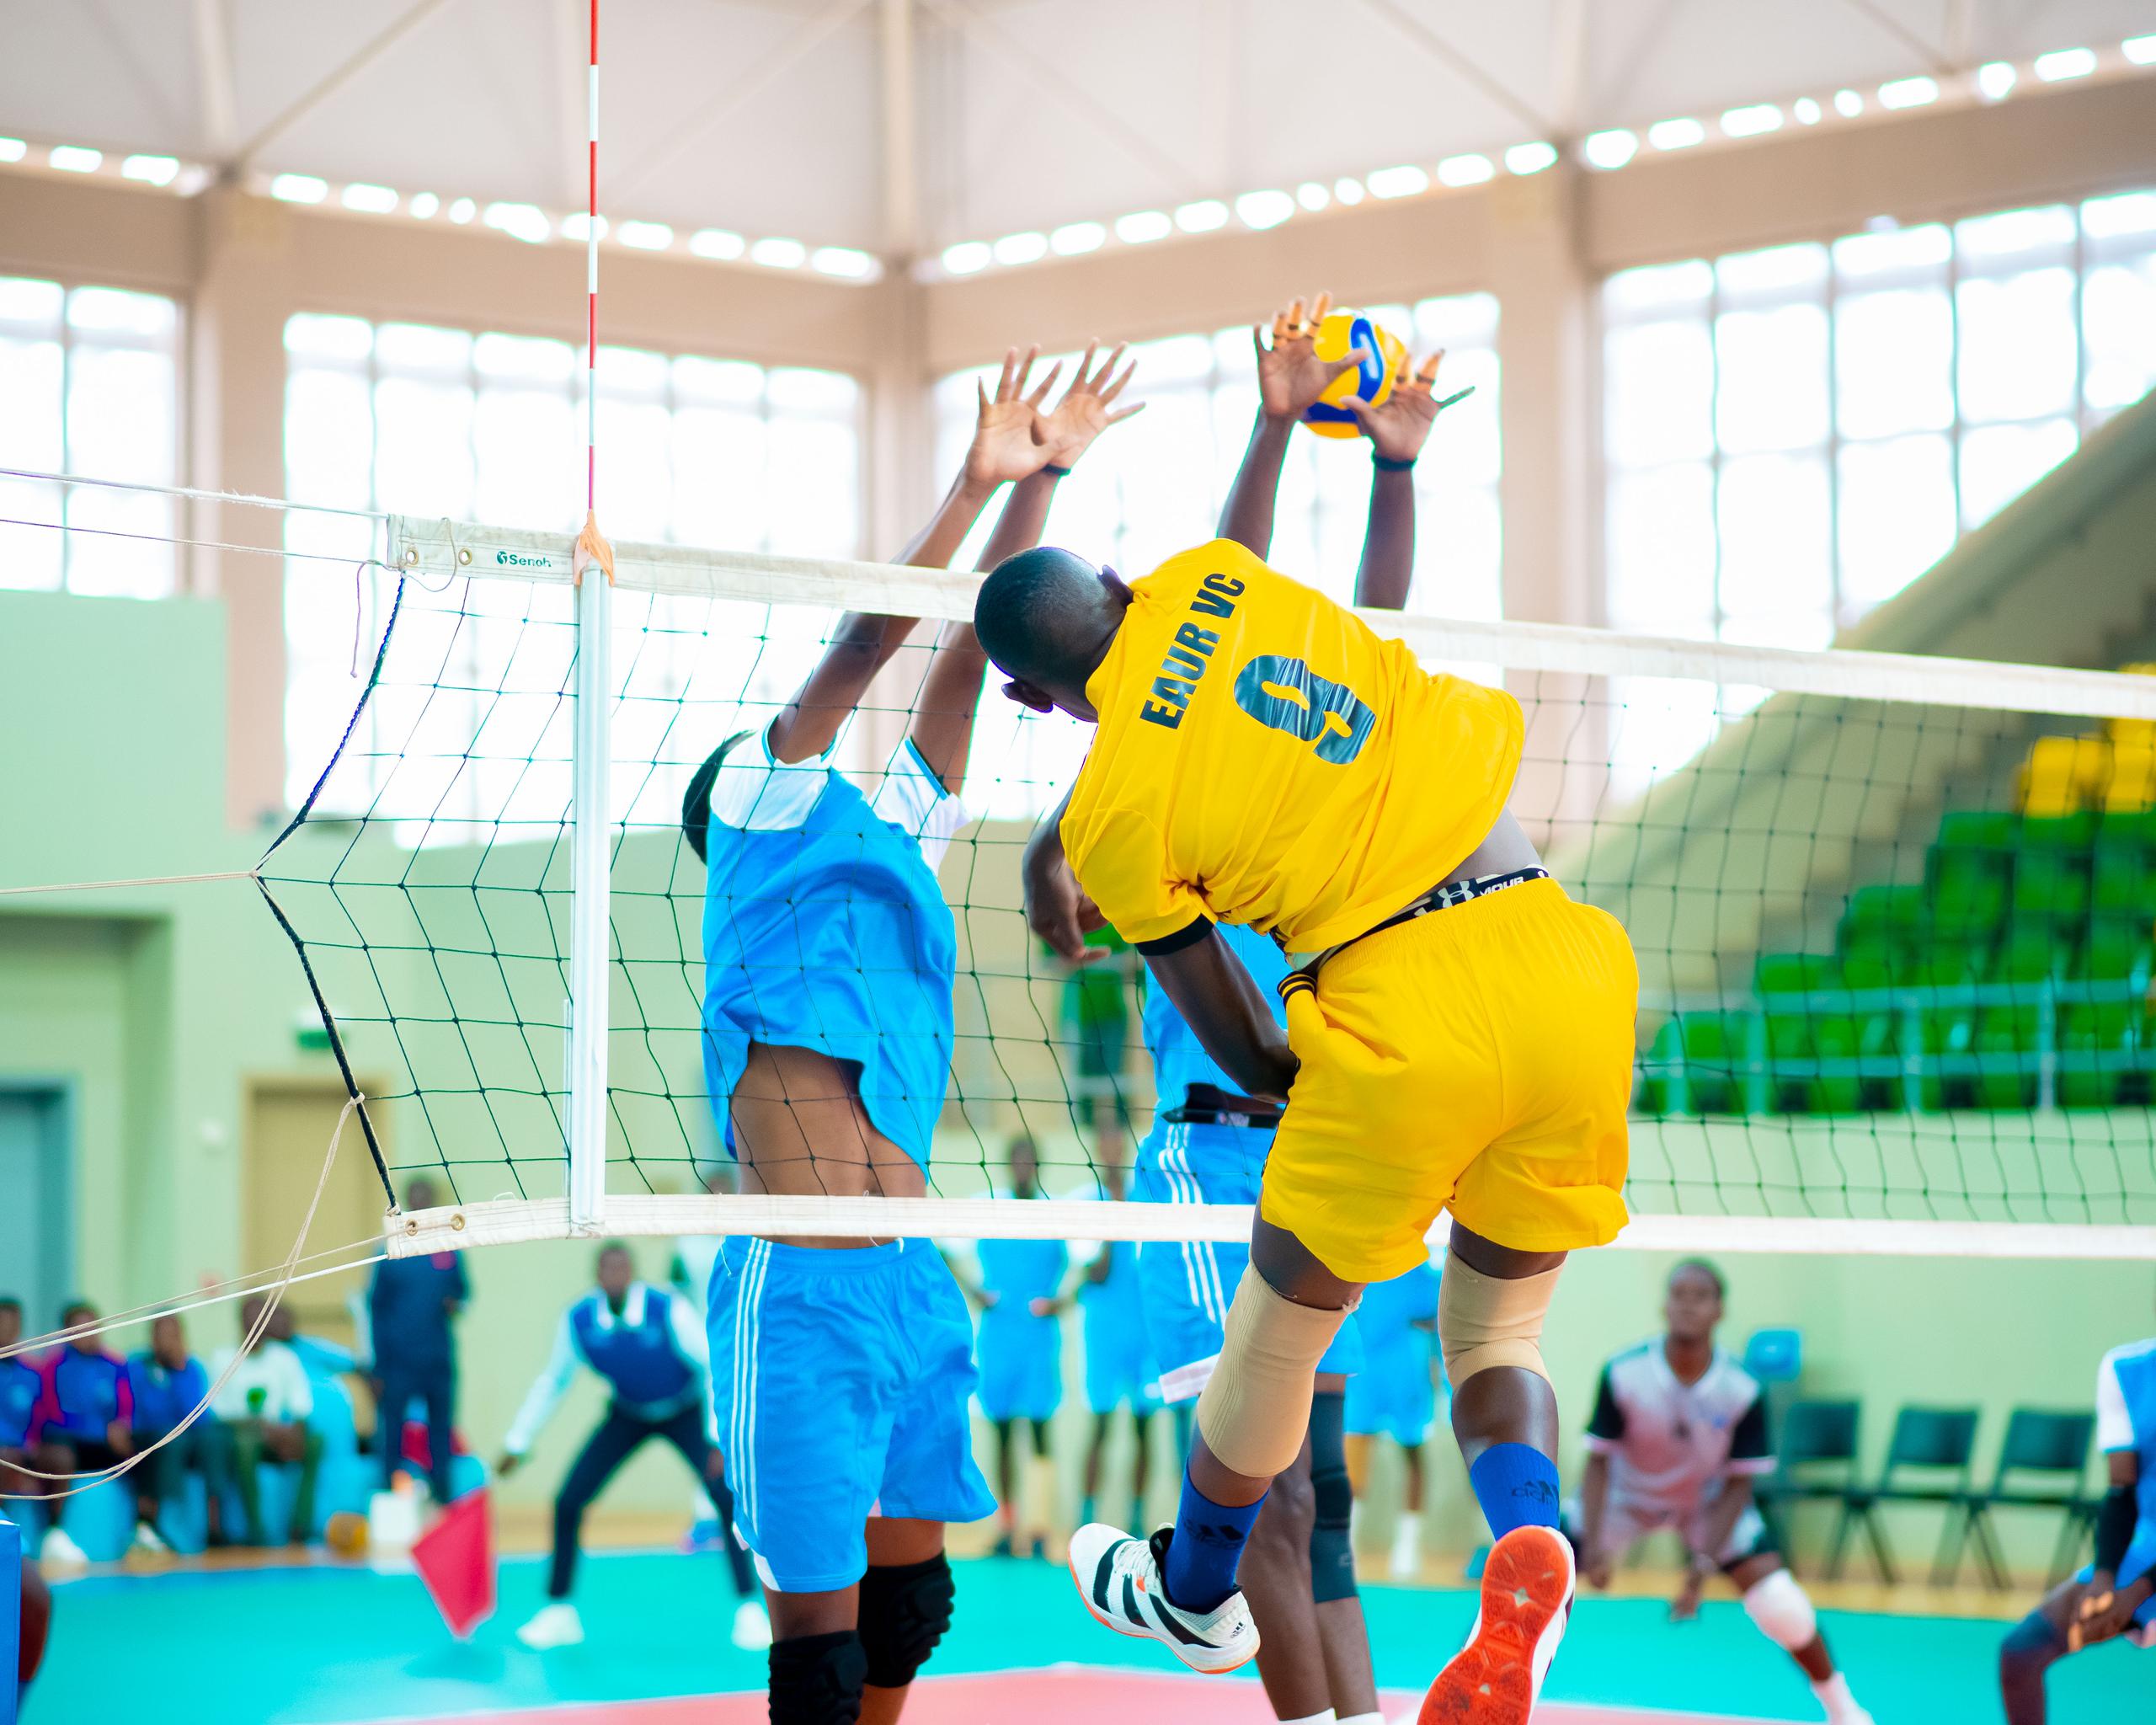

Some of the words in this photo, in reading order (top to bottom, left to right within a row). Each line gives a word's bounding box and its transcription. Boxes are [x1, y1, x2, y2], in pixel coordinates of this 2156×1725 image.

[1139, 622, 1221, 729] EAUR
[1189, 573, 1246, 619] VC
[1233, 654, 1377, 765] 9
